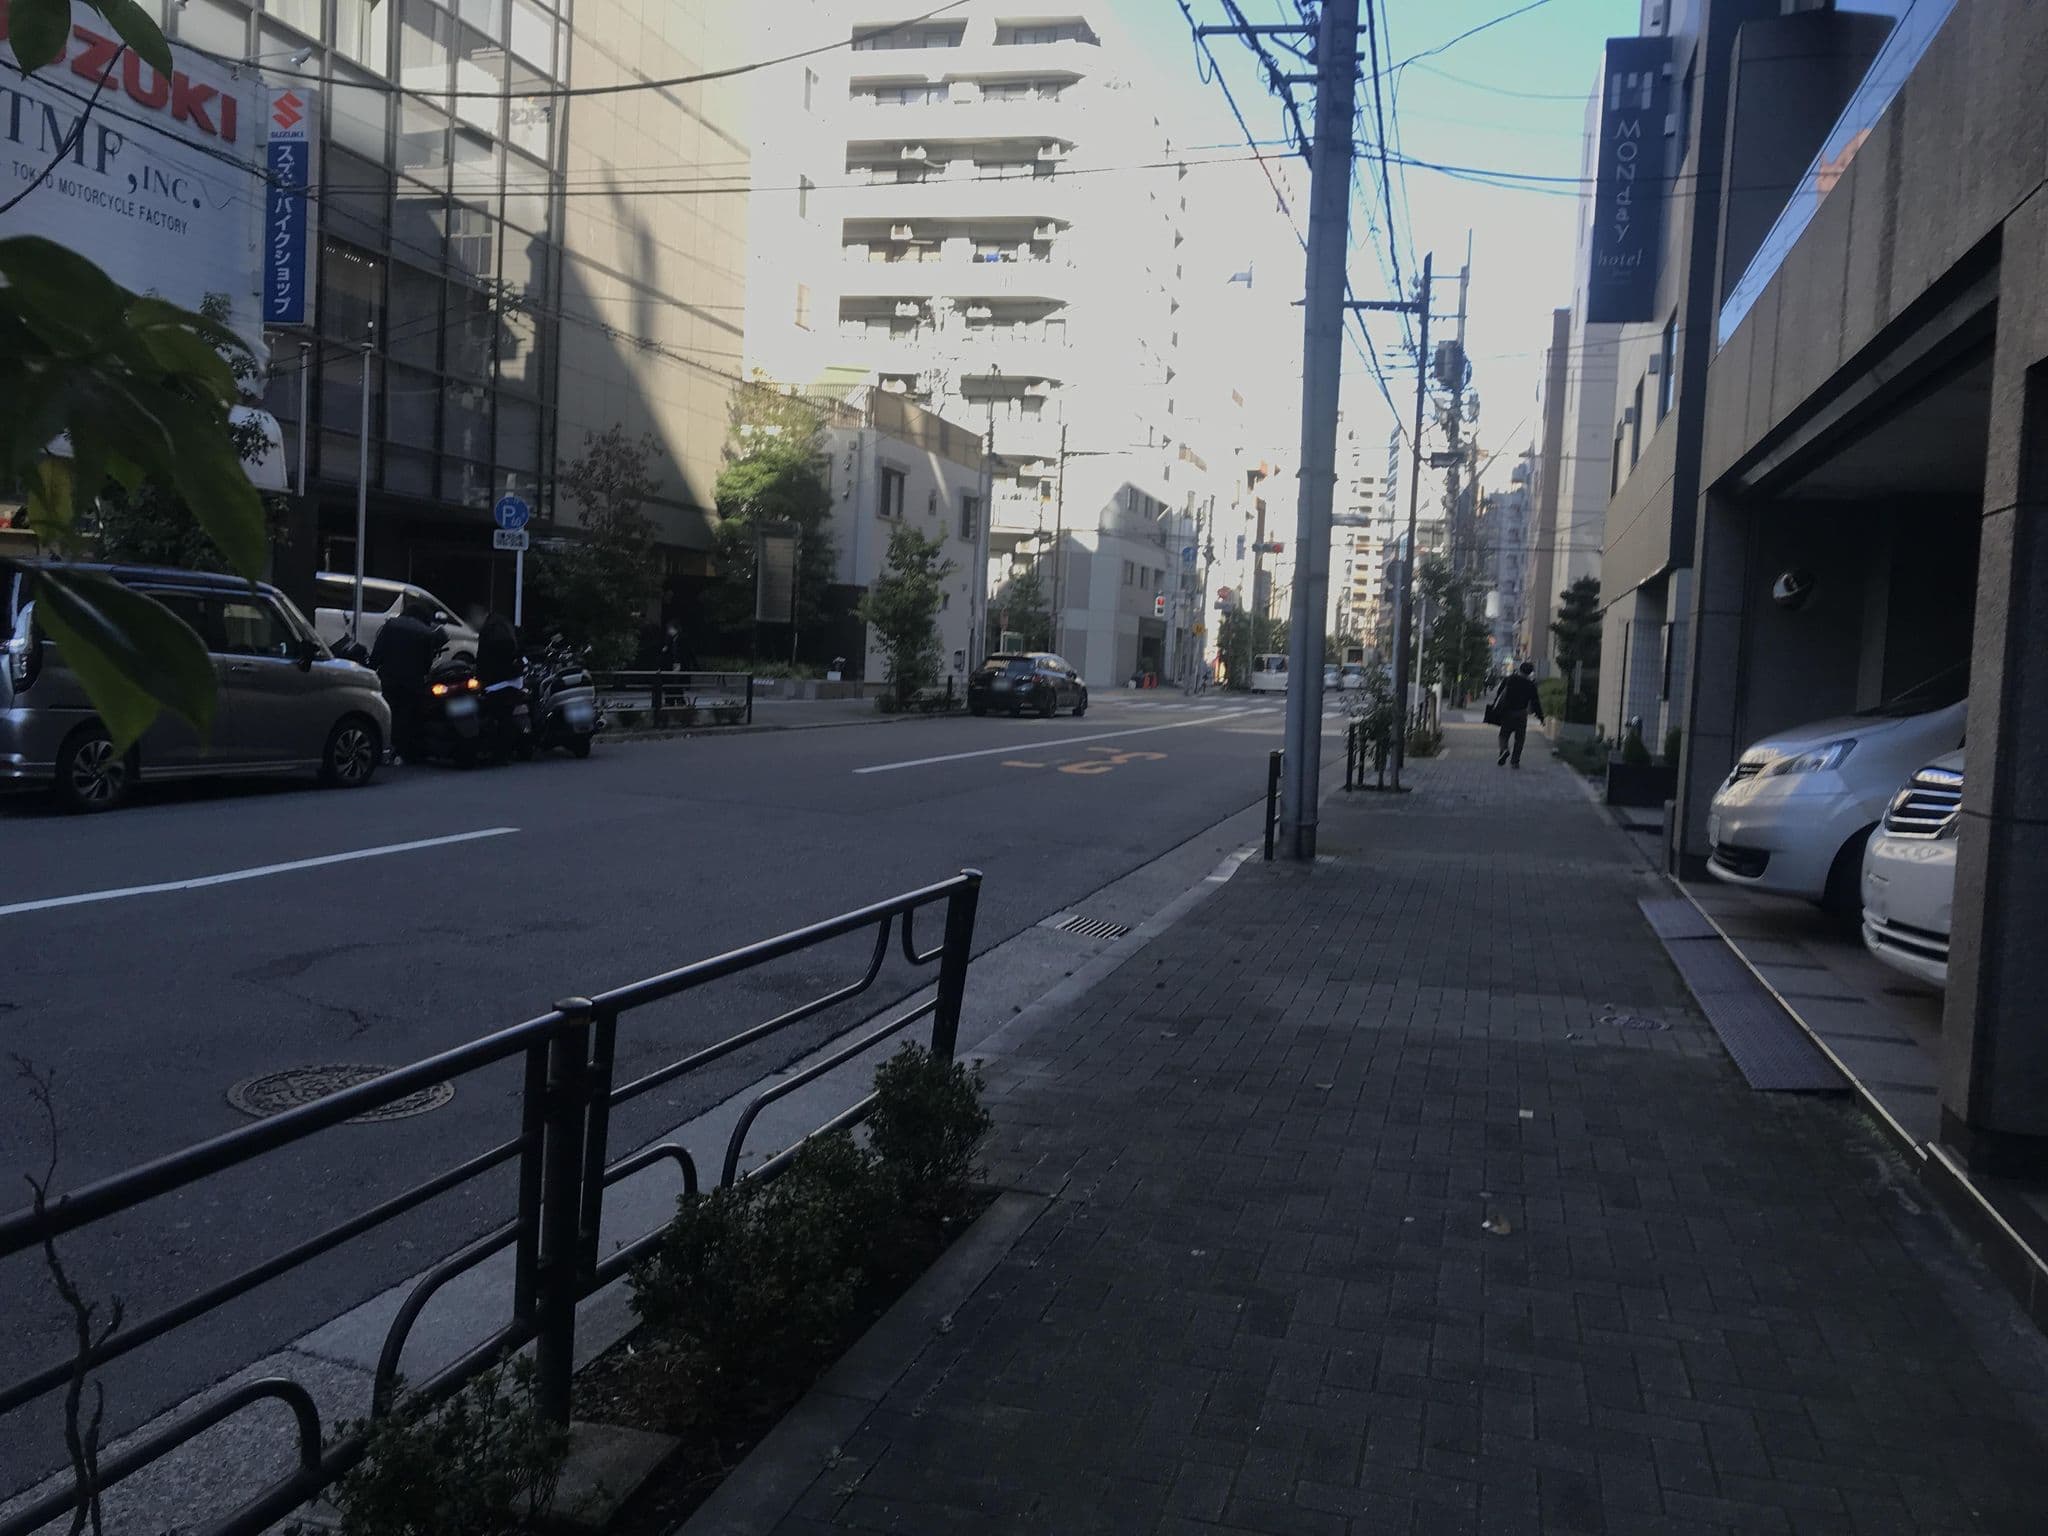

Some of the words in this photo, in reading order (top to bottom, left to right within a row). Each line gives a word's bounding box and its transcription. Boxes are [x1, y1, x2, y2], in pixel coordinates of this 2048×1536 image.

[0, 0, 237, 143] ZUKI
[13, 161, 54, 188] TOKO
[59, 176, 135, 216] MOTORCYCLE
[139, 205, 188, 235] FACTORY
[1597, 248, 1643, 267] hotel
